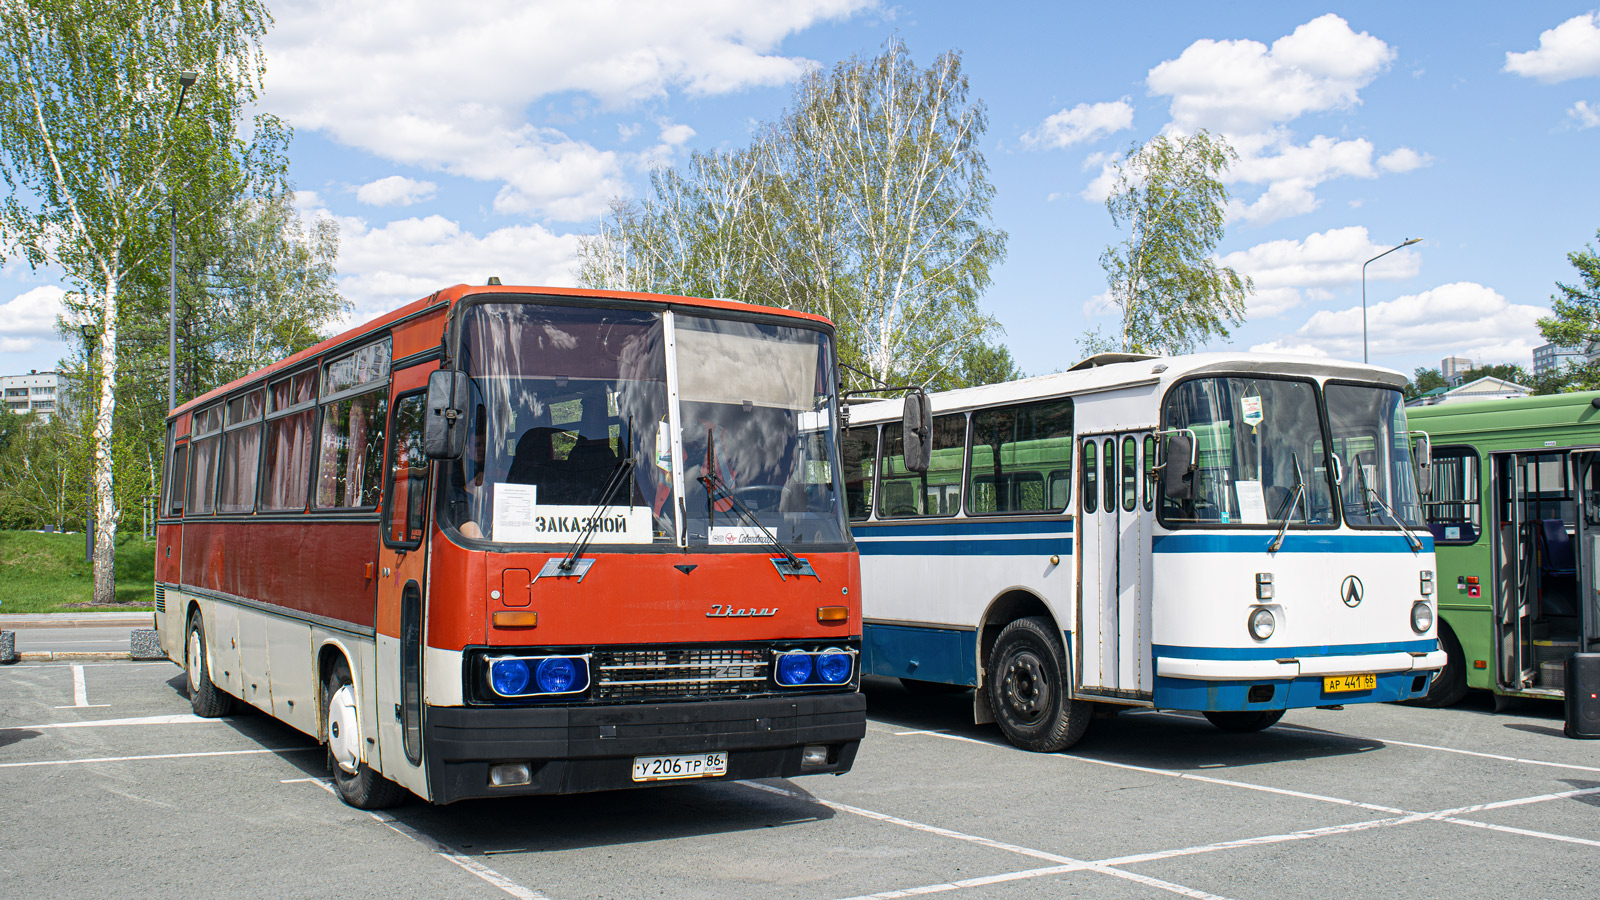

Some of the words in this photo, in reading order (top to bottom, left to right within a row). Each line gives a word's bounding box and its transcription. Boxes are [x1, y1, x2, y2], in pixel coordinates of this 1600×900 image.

[535, 514, 627, 533] ЗАКАЗНОЙ
[706, 604, 779, 618] Ikarus
[716, 666, 754, 678] 256
[1344, 676, 1361, 688] 441
[1365, 674, 1374, 684] 66
[653, 758, 681, 775] 206
[706, 754, 721, 767] 86
